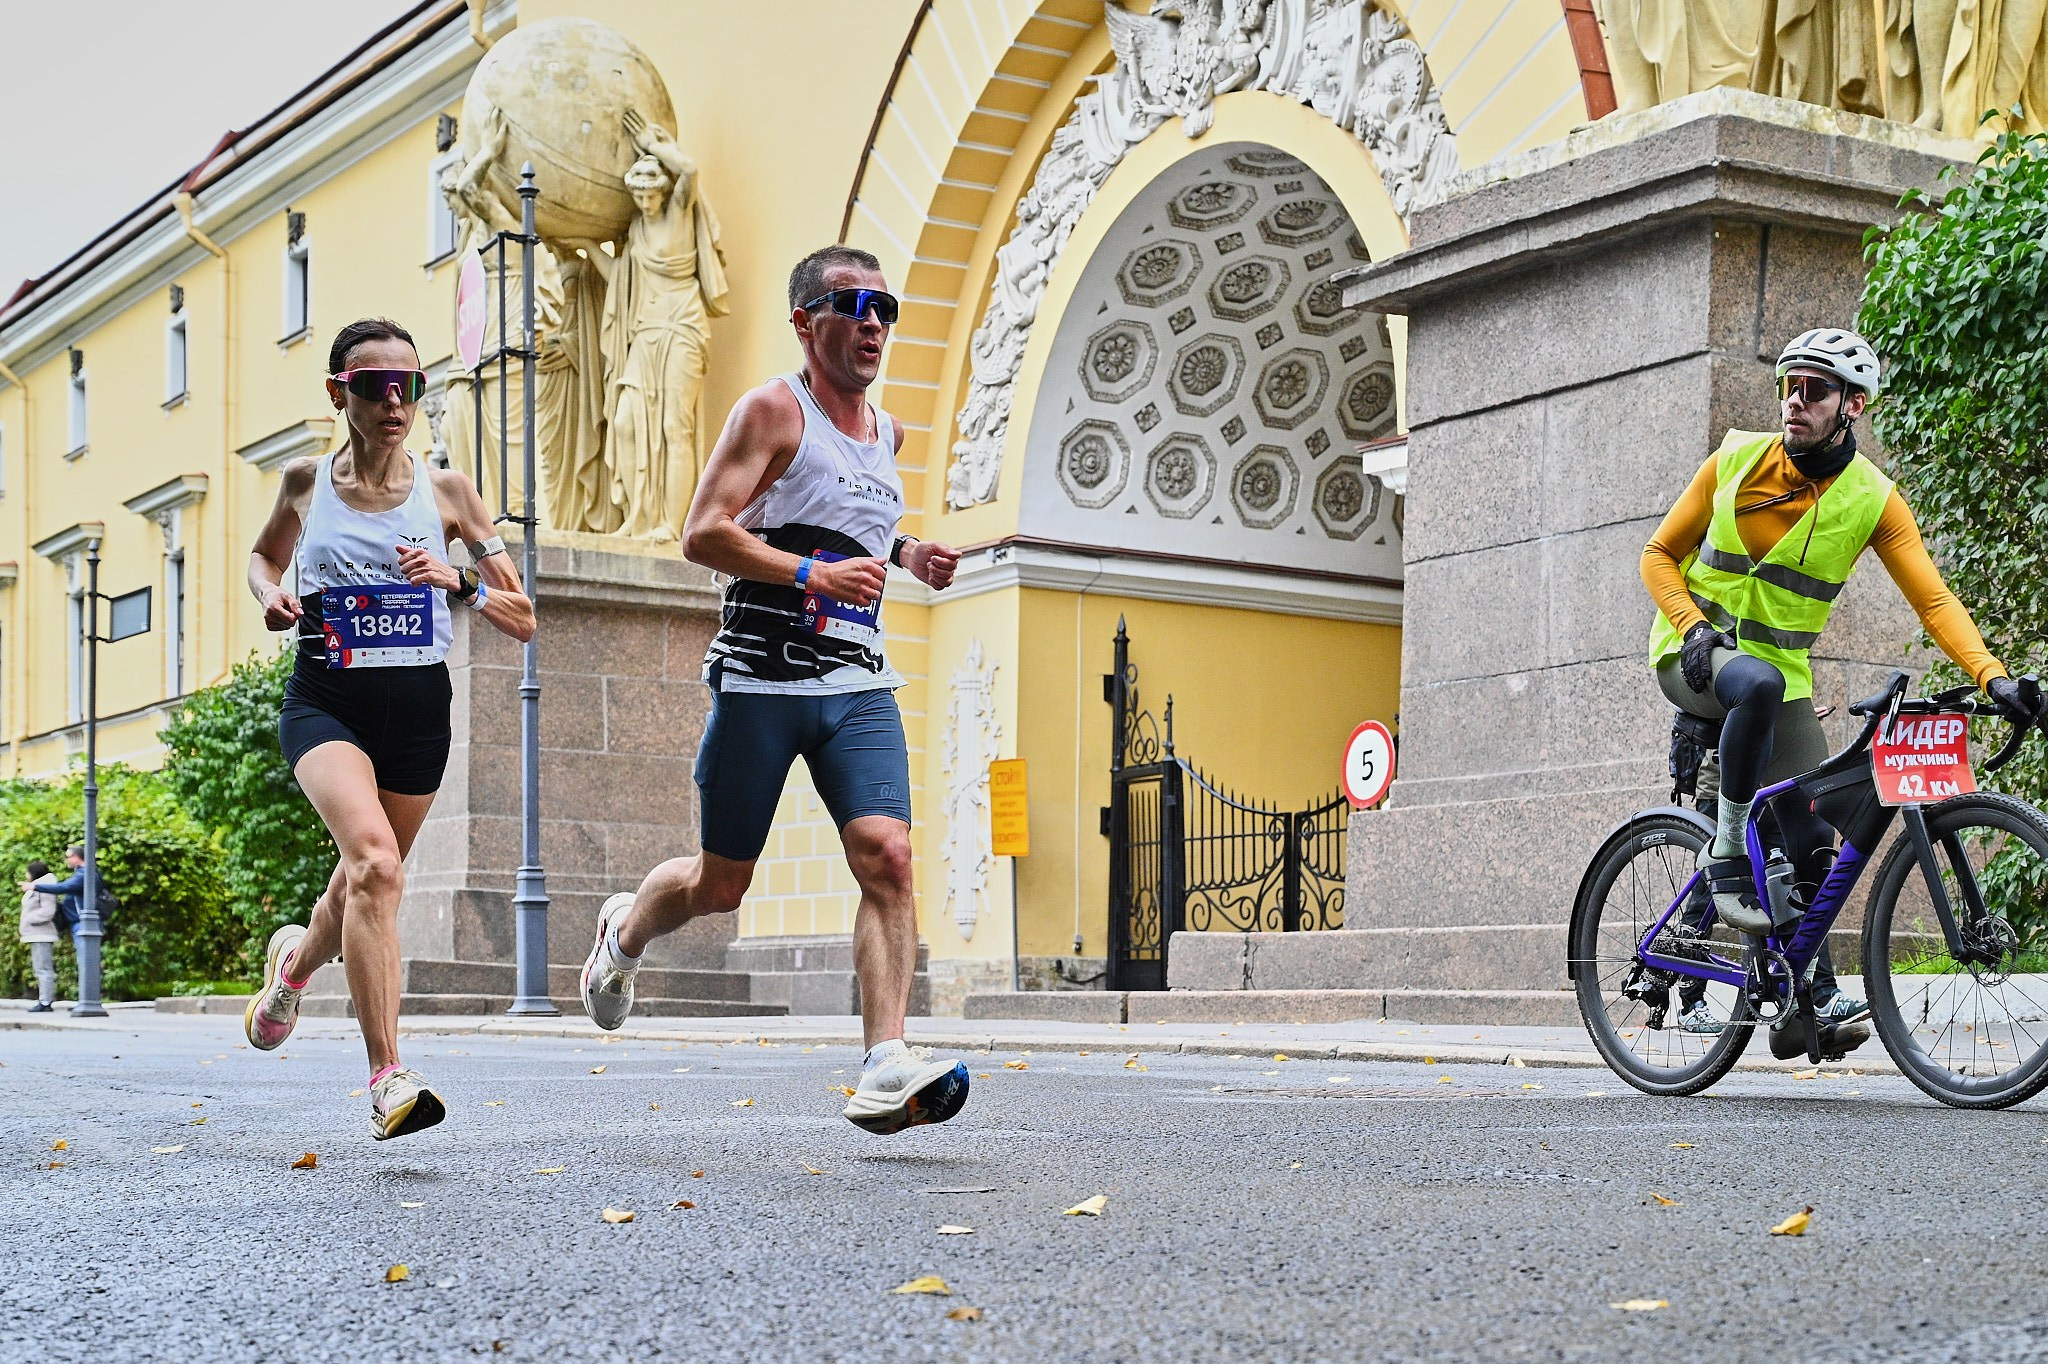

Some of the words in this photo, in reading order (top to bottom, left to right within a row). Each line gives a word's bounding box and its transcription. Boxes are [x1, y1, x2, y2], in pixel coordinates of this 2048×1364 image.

[459, 288, 484, 336] STOP
[838, 476, 898, 503] PIRANHA
[319, 562, 391, 571] PIRAN
[806, 598, 817, 611] A
[350, 613, 423, 637] 13842
[804, 614, 815, 623] 30
[328, 635, 340, 648] A
[329, 651, 340, 659] 30
[1362, 749, 1374, 781] 5
[1884, 753, 1959, 771] мужчины
[1897, 775, 1928, 798] 42
[1791, 861, 1857, 952] CANYON
